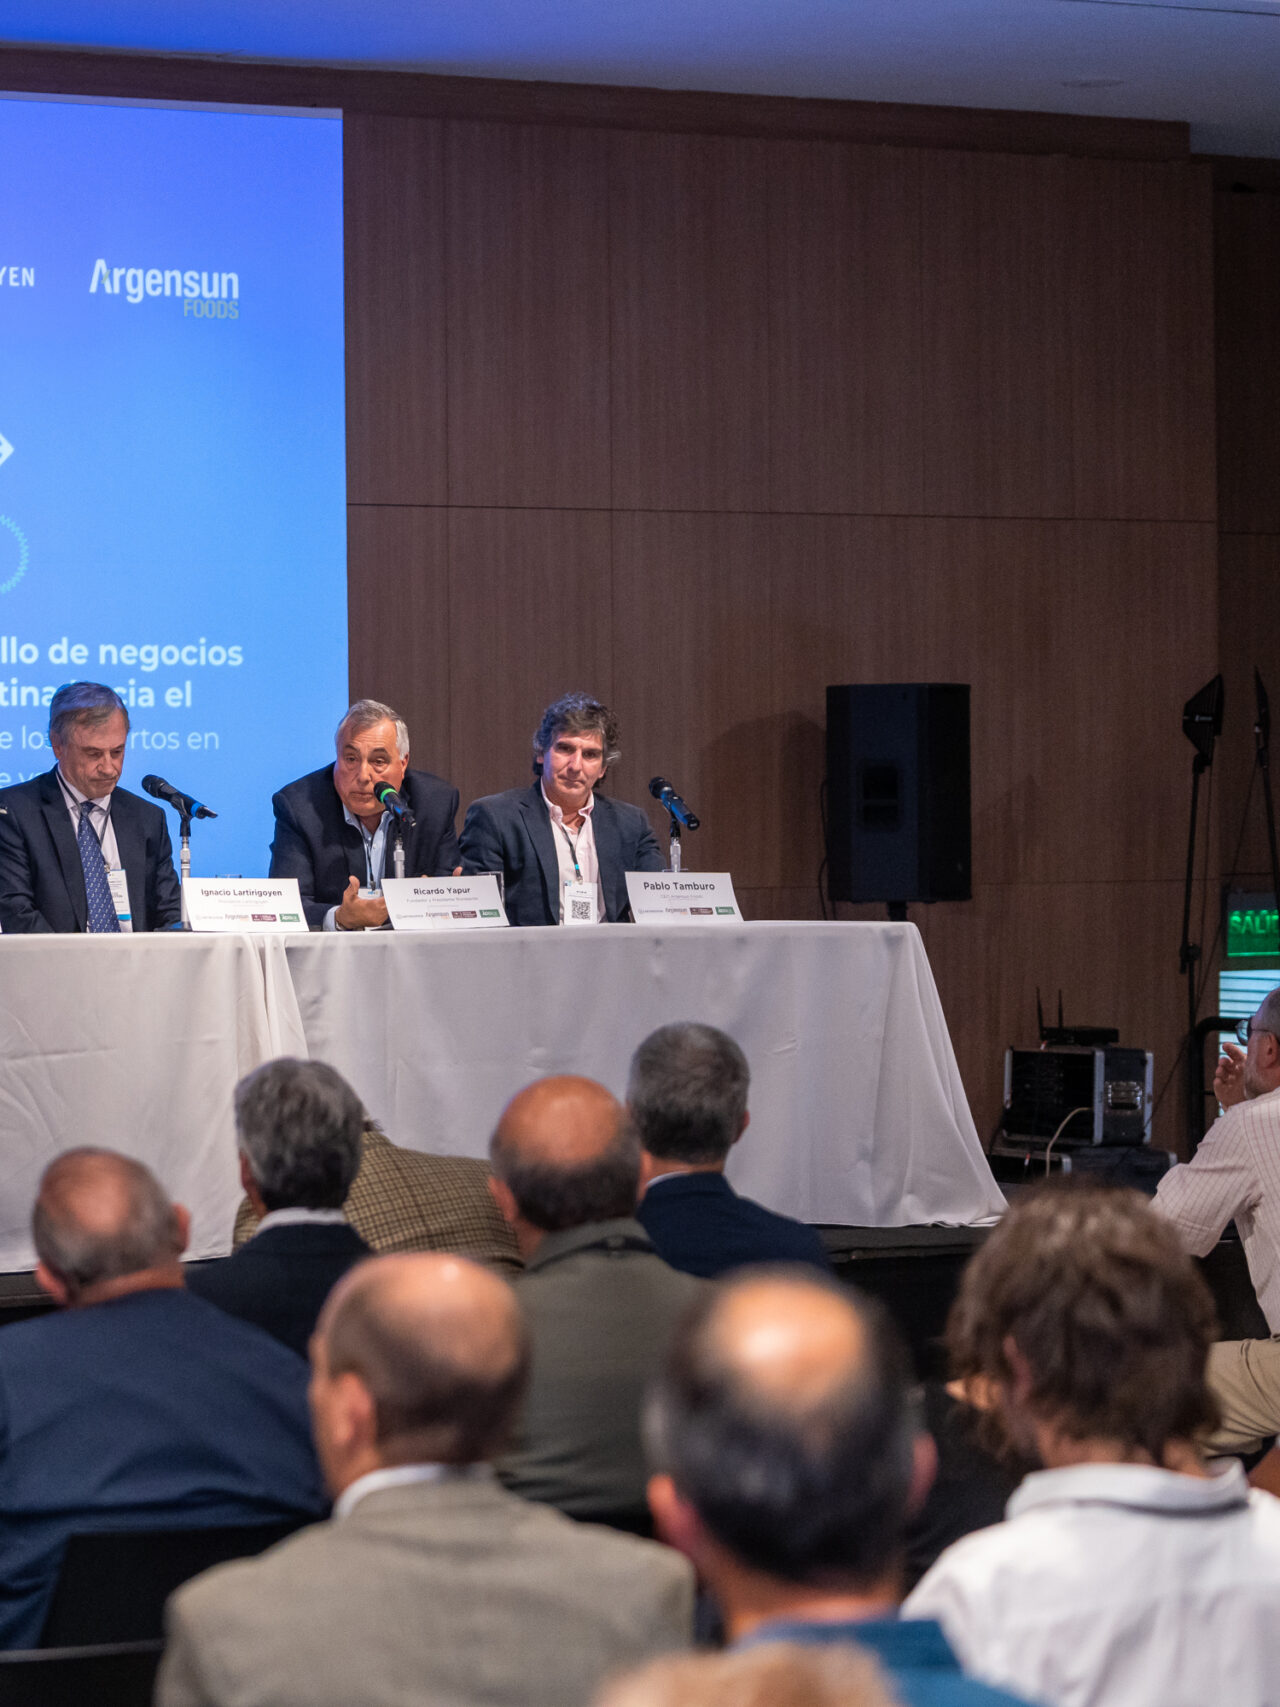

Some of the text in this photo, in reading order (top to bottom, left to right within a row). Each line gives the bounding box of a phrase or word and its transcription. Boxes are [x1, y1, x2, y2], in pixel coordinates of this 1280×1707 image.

[89, 258, 239, 304] Argensun
[183, 298, 240, 319] FOODS
[47, 636, 89, 665] de
[99, 636, 244, 672] negocios
[164, 680, 193, 708] el
[186, 730, 220, 750] en
[201, 888, 283, 898] Ignacio Lartirigoyen
[413, 887, 471, 896] Ricardo Yapur
[643, 882, 716, 891] Pablo Tamburo
